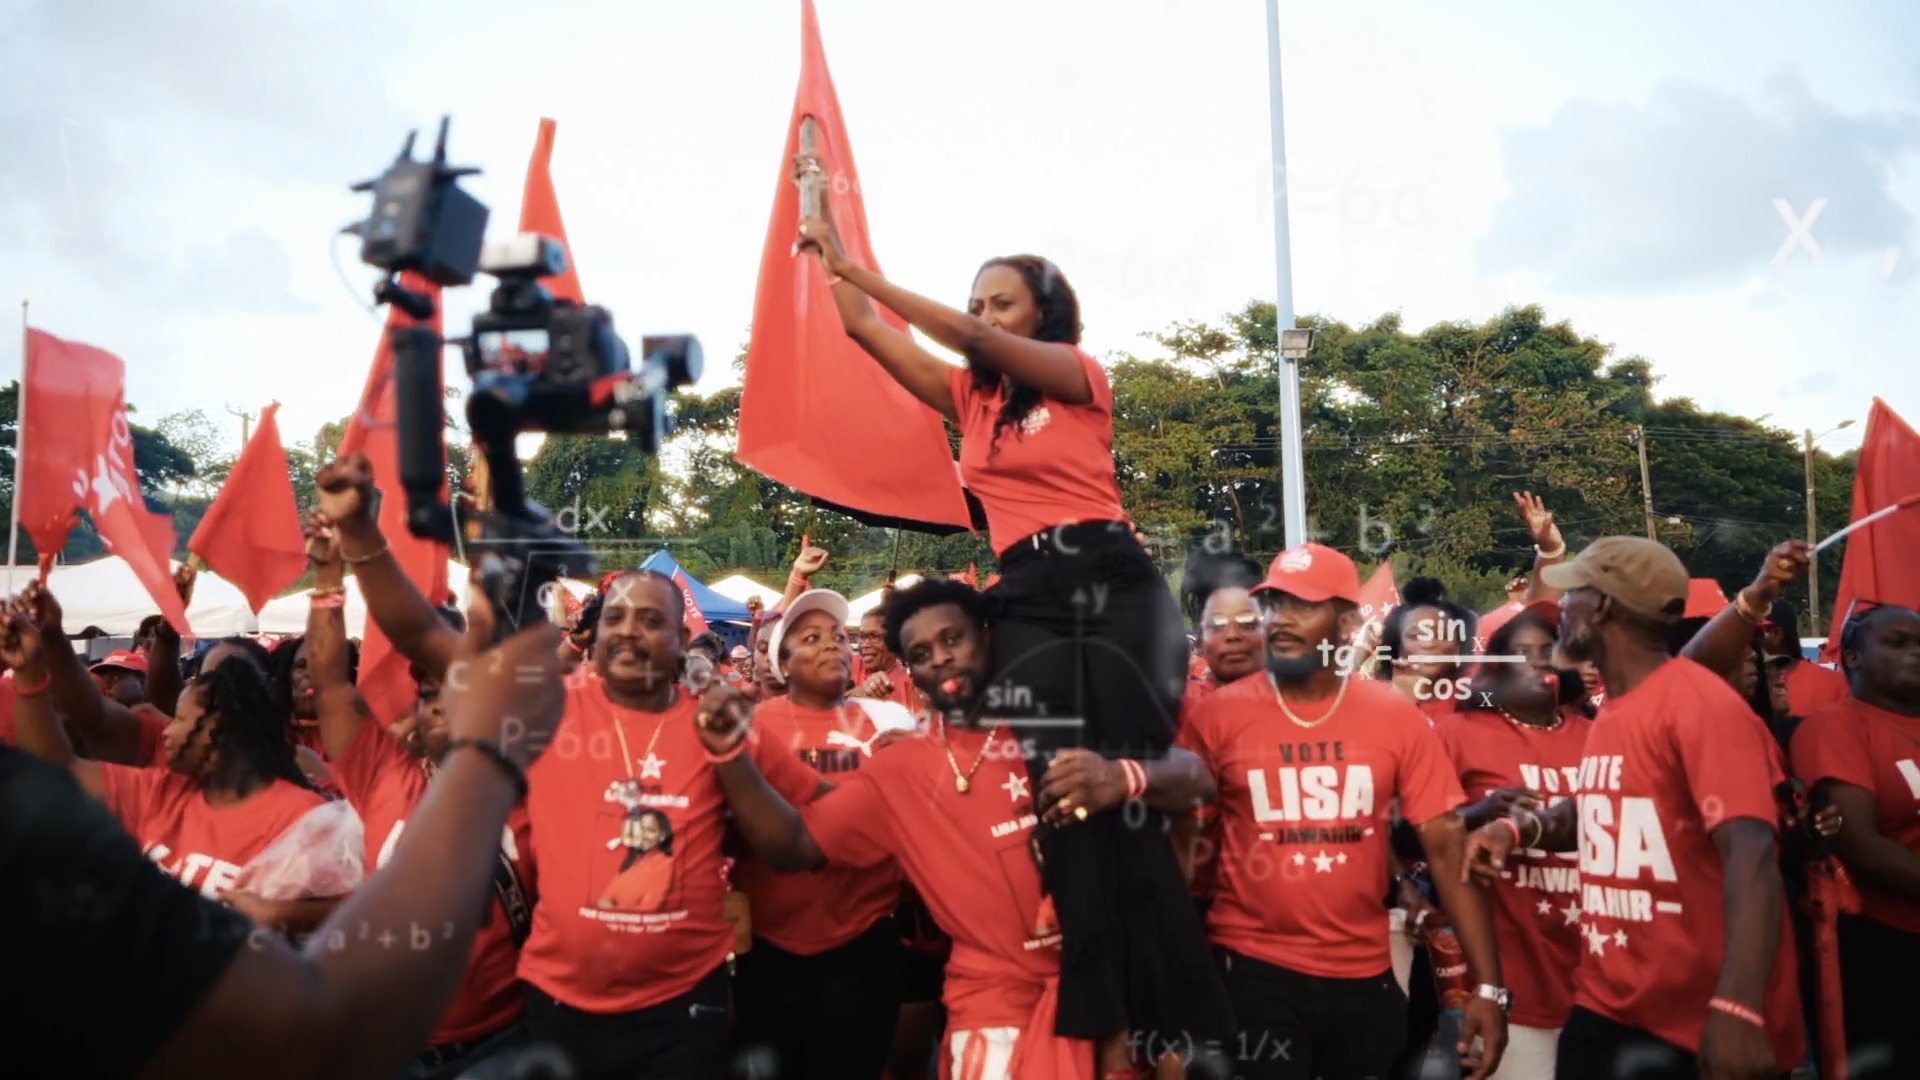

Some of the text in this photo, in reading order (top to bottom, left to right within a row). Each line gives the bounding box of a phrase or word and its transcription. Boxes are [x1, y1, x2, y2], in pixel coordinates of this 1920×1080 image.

[1279, 741, 1345, 763] VOTE
[1519, 763, 1579, 793] VOT
[1247, 765, 1375, 822] LISA
[1515, 864, 1581, 894] JAWA
